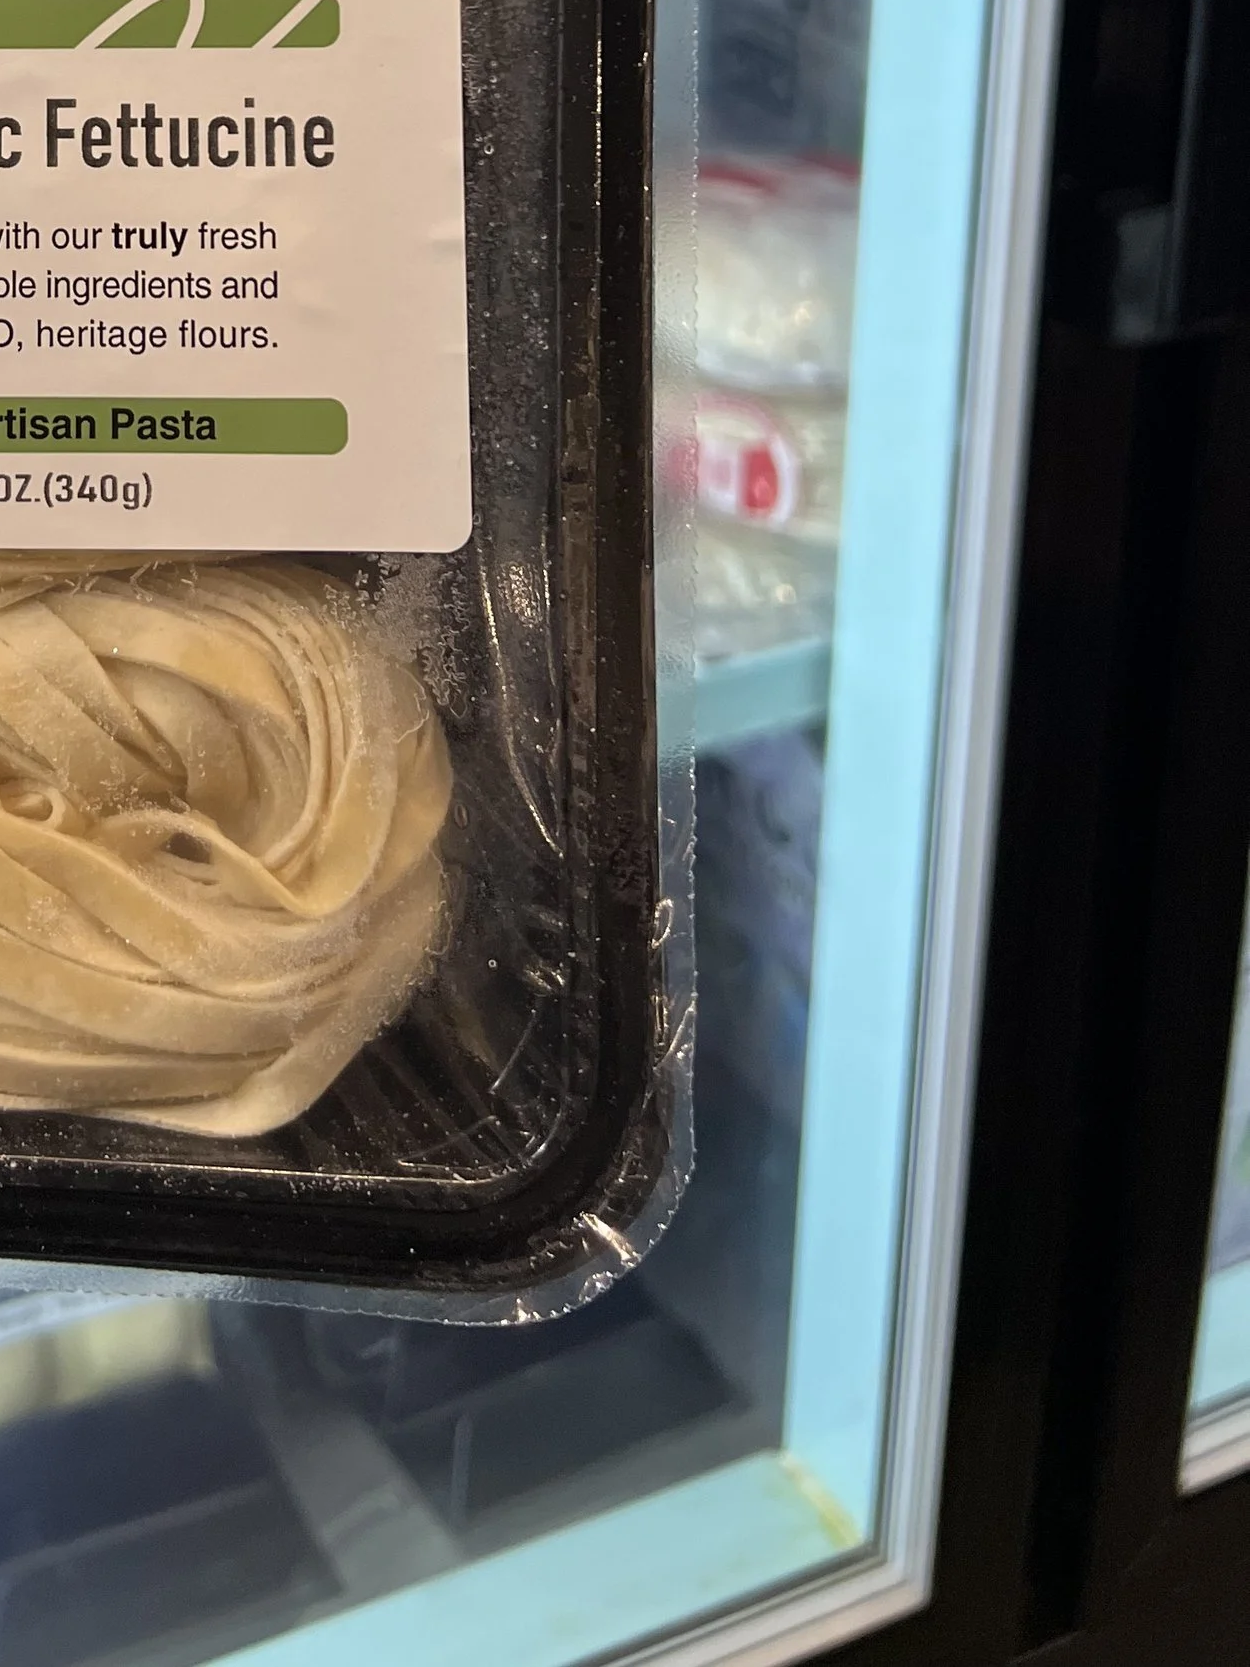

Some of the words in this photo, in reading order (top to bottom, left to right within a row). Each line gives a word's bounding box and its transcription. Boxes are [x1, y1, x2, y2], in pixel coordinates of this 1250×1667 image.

[46, 97, 335, 168] Fettucine
[52, 228, 102, 250] our
[112, 222, 188, 257] truly
[198, 222, 277, 250] fresh
[47, 270, 211, 306] ingredients
[222, 271, 277, 299] and
[38, 319, 167, 356] heritage
[179, 320, 278, 348] flours.
[111, 408, 218, 441] Pasta
